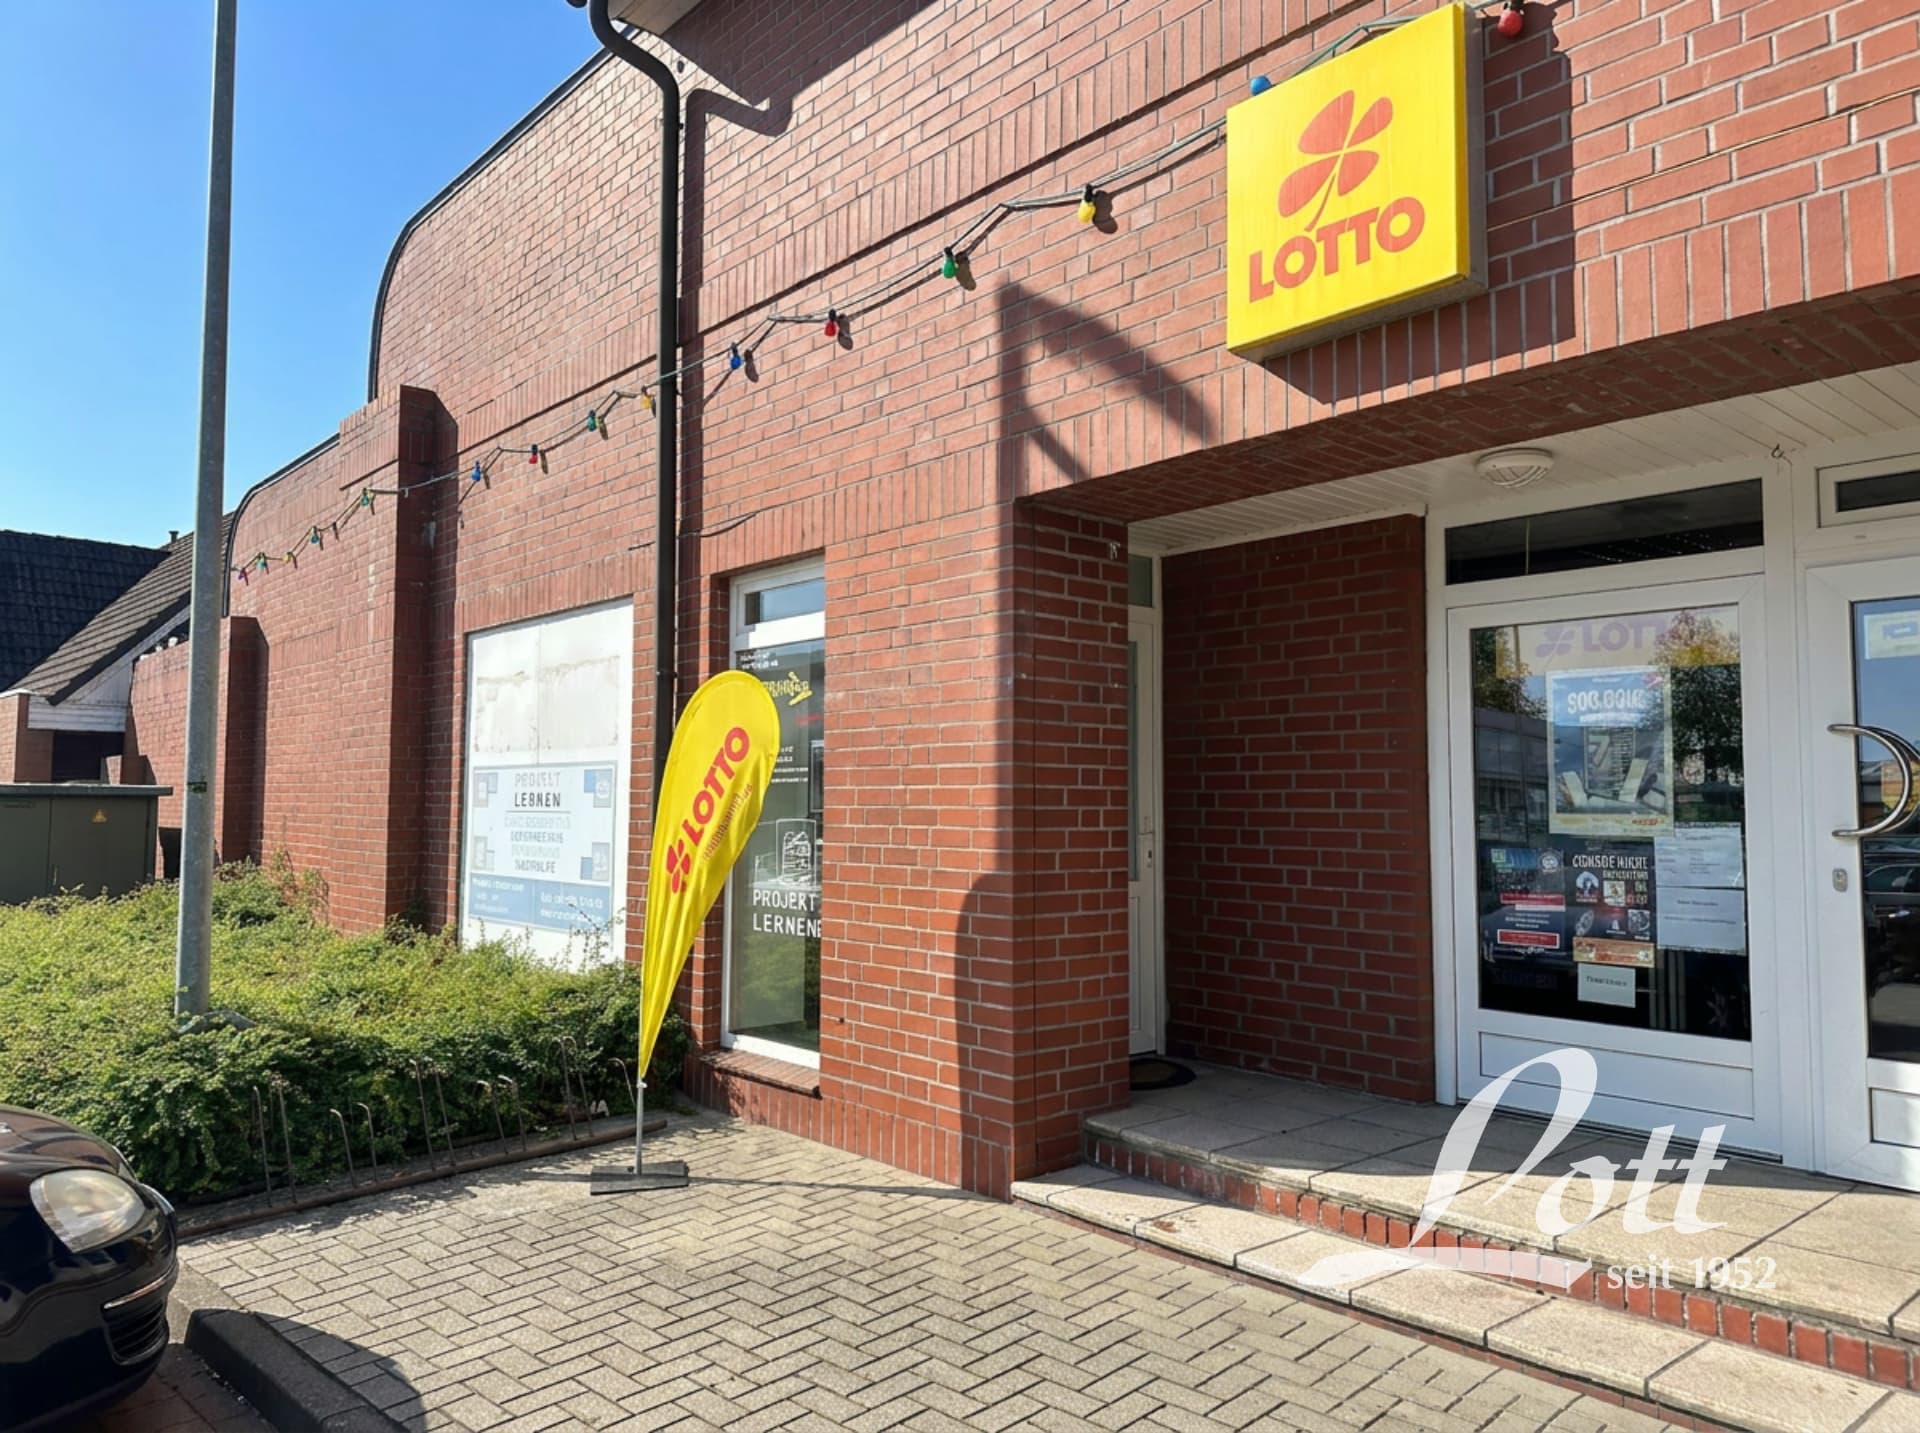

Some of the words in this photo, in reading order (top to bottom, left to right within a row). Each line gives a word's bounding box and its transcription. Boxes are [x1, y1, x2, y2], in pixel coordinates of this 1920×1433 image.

[1249, 196, 1426, 304] LOTTO
[1582, 615, 1670, 653] LOTT
[681, 726, 750, 847] LOTTO
